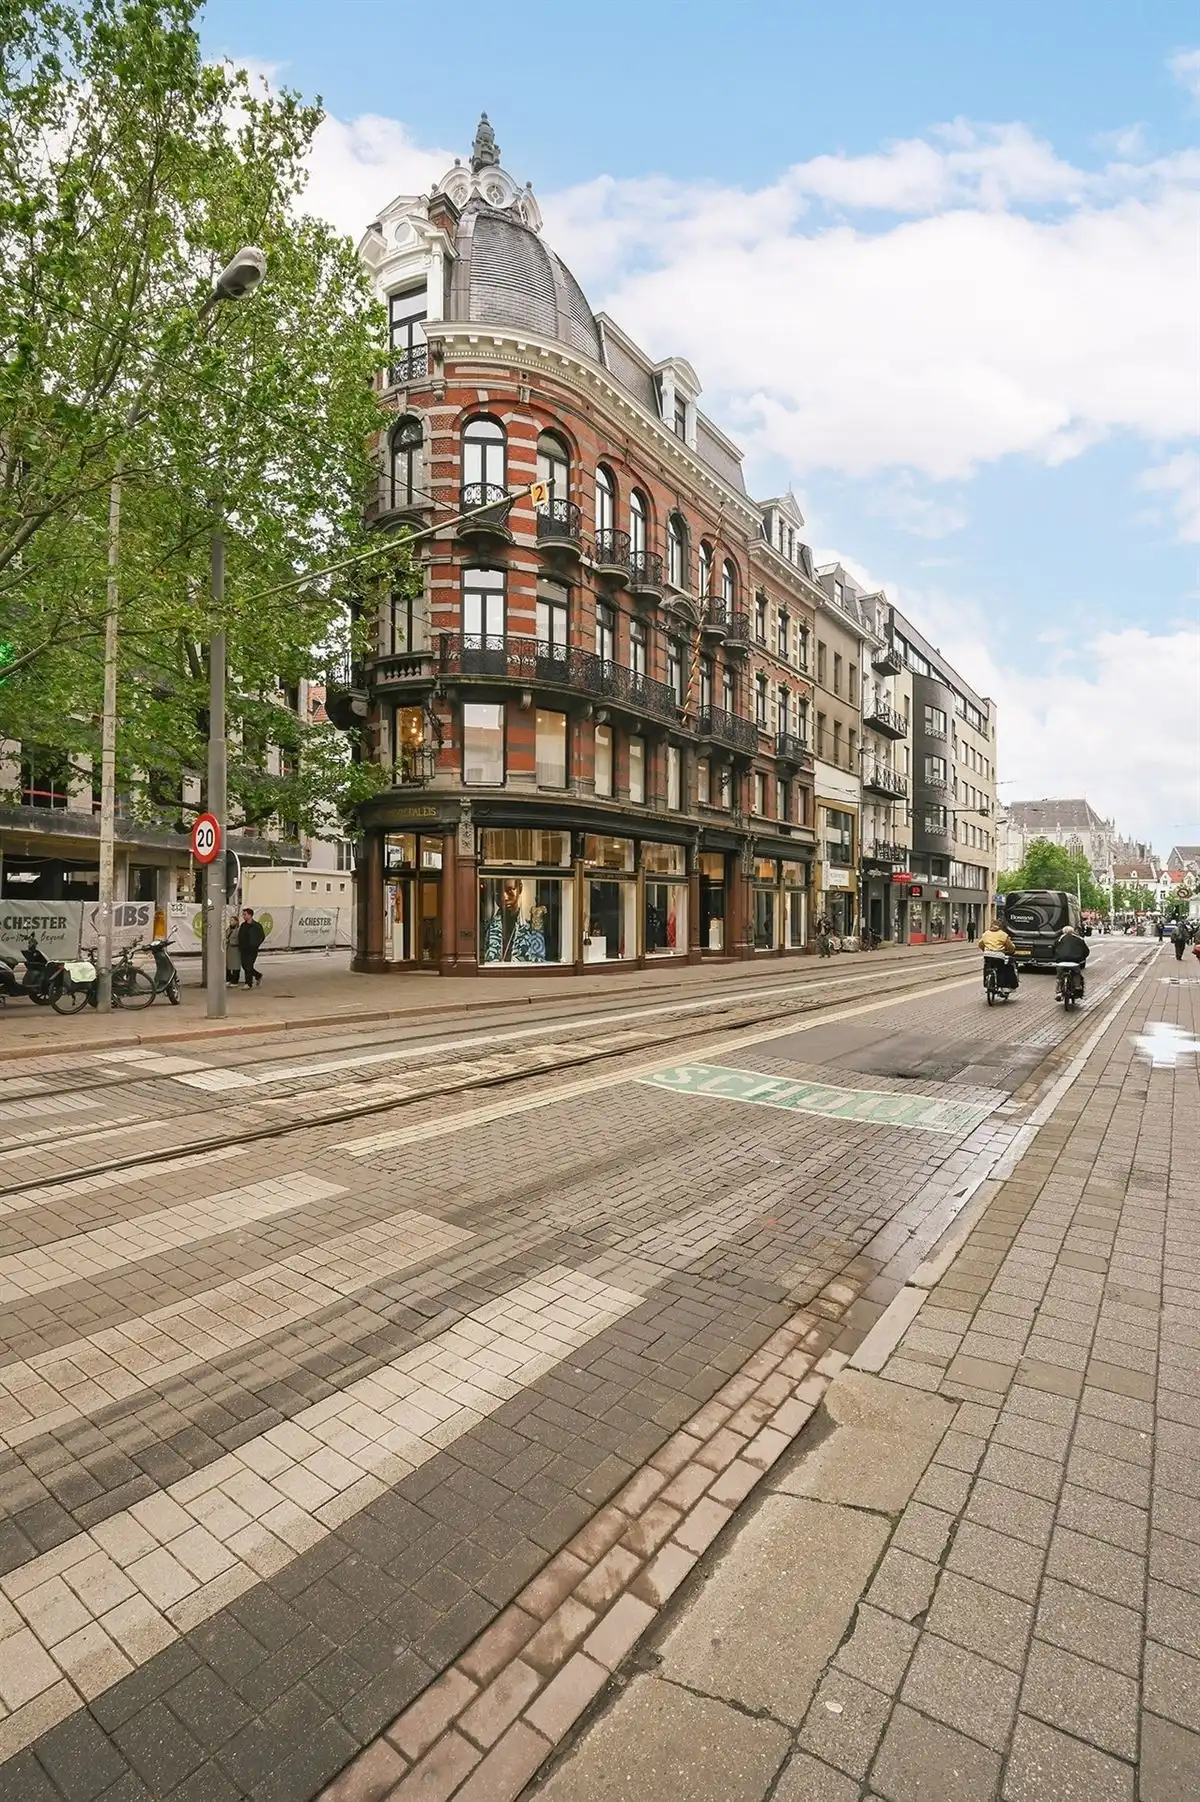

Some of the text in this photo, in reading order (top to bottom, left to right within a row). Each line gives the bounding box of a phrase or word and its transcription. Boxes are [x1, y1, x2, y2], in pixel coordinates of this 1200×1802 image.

[535, 485, 545, 502] 2
[197, 828, 214, 847] 20
[114, 905, 150, 927] IBS
[653, 1067, 952, 1126] SCHOOL
